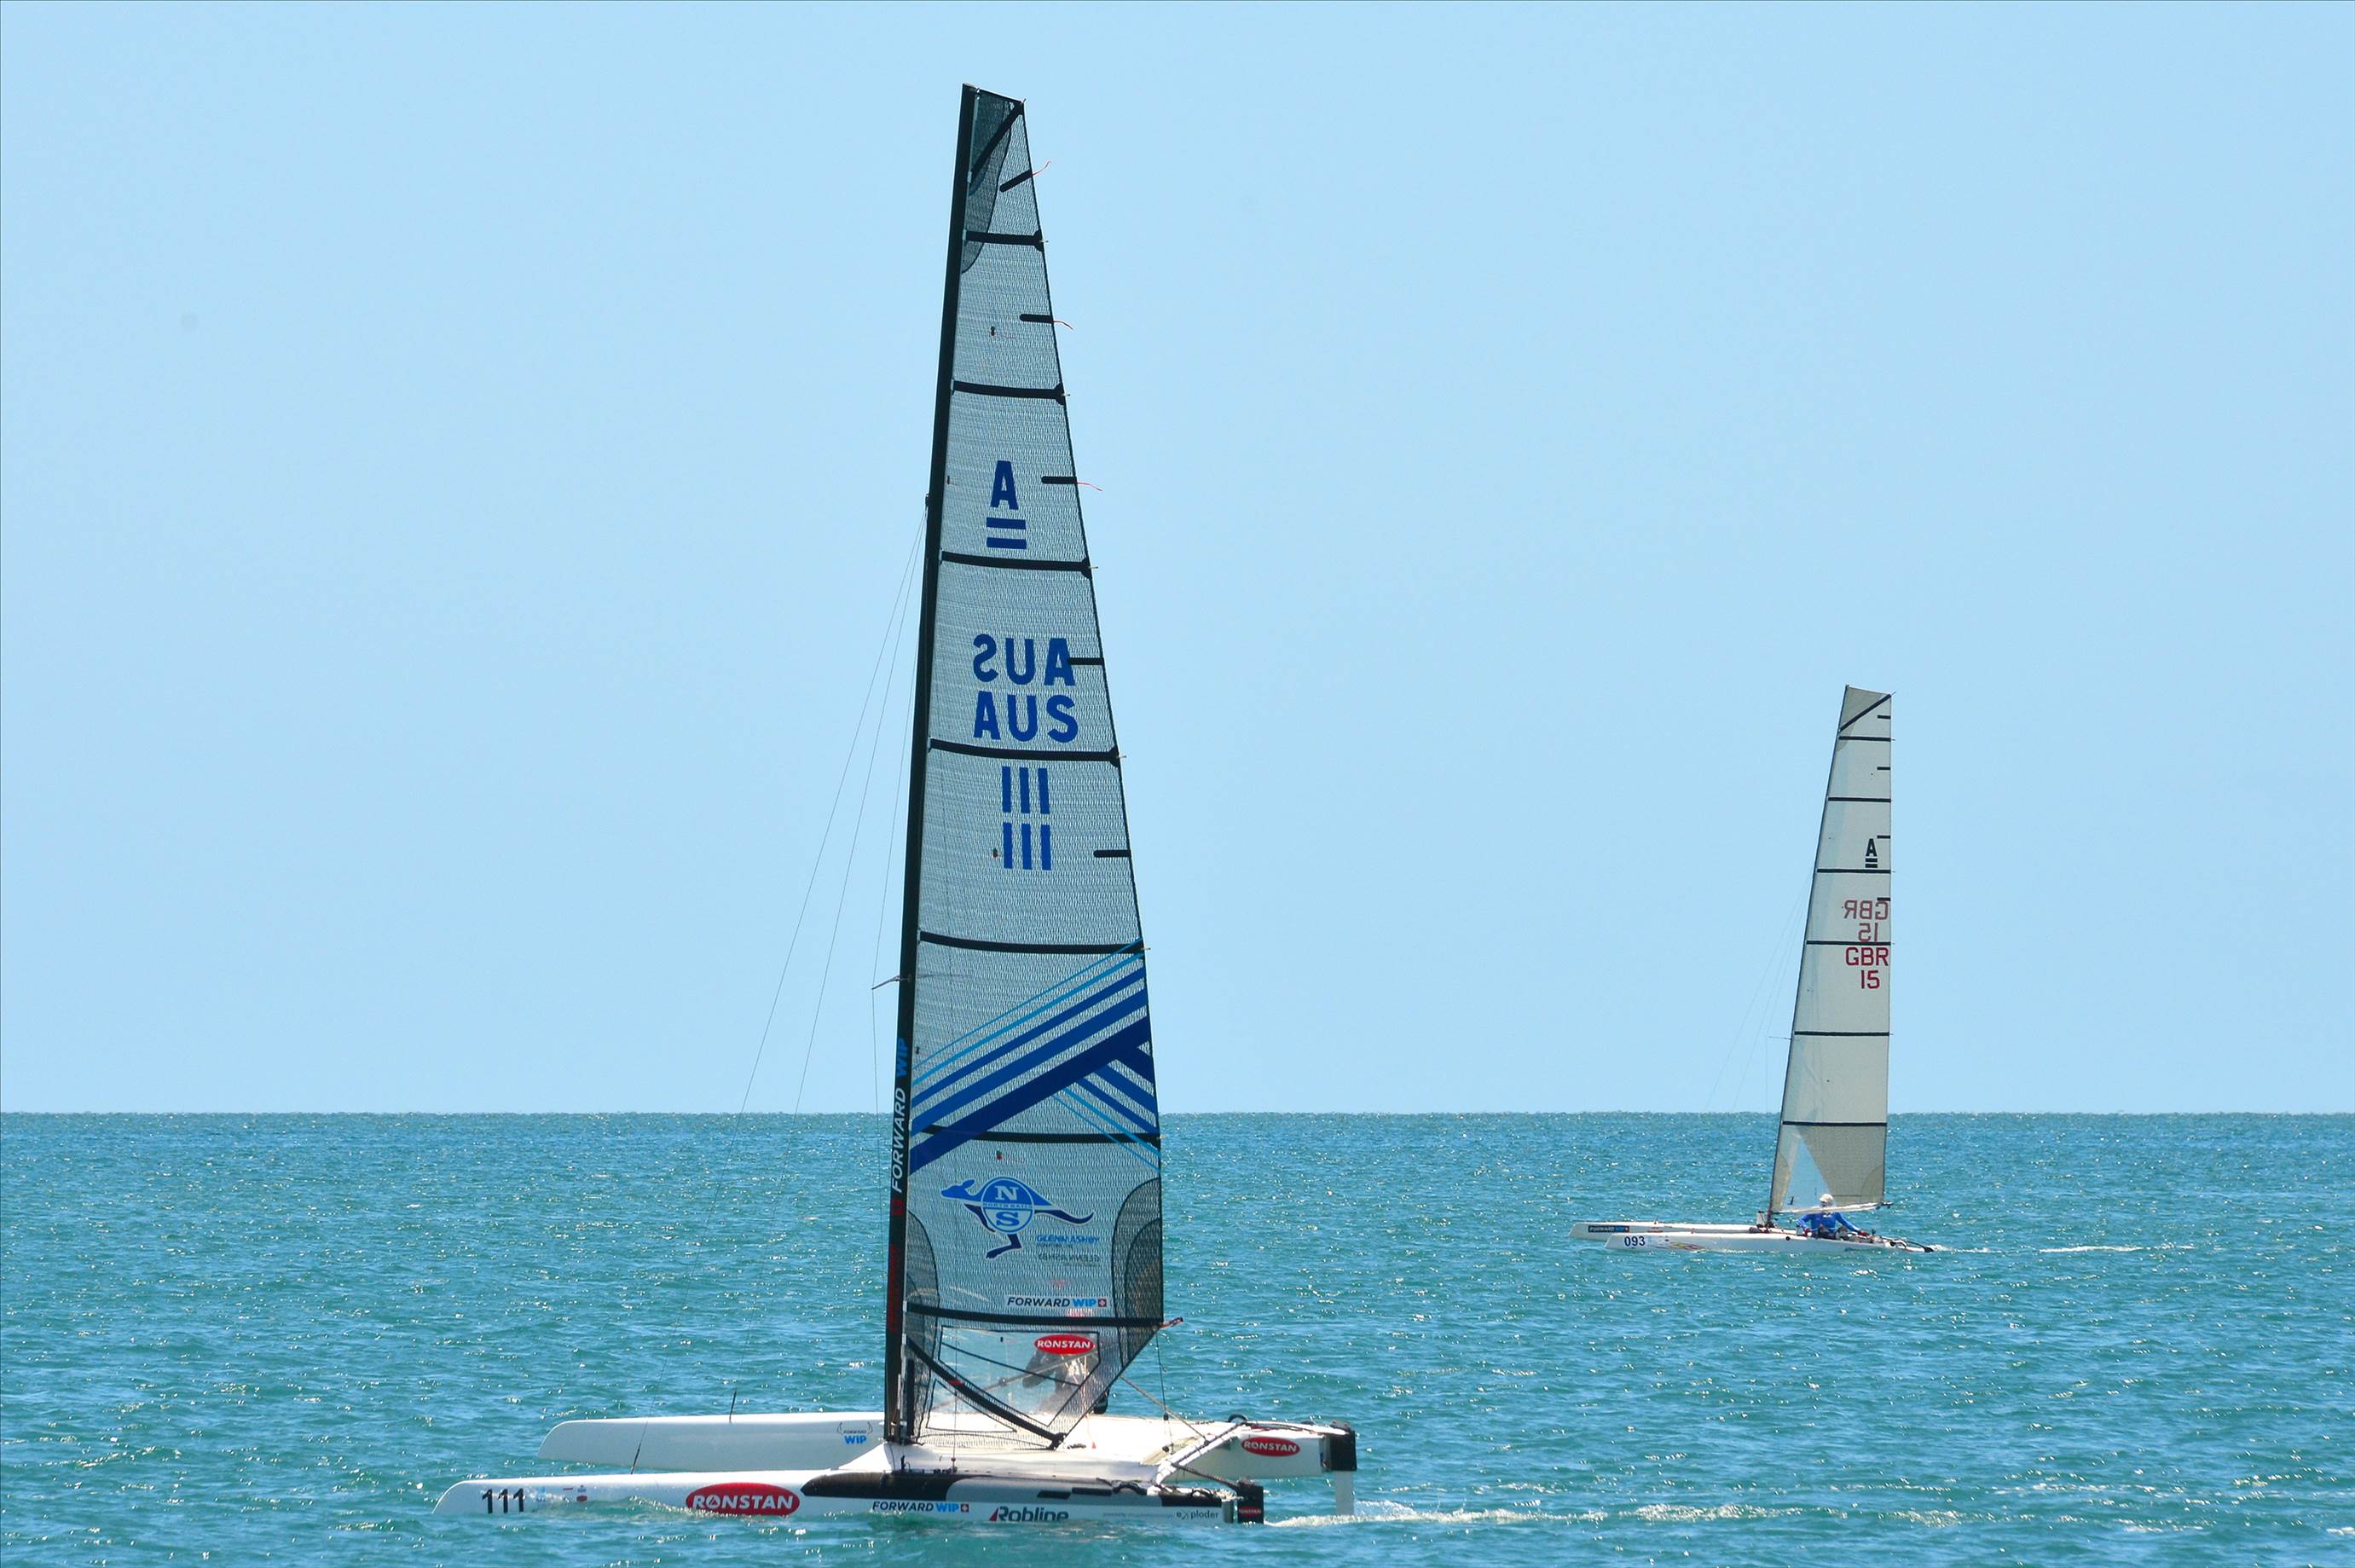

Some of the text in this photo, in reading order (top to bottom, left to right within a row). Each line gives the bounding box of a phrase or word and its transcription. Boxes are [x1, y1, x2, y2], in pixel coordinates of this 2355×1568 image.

[989, 460, 1019, 510] A
[973, 691, 1079, 743] AUS
[1865, 838, 1878, 857] A
[1845, 946, 1889, 966] GBR
[1860, 970, 1880, 989] 15
[892, 1037, 909, 1193] FORWARD WIP
[994, 1185, 1019, 1201] N
[995, 1211, 1020, 1227] S
[1623, 1235, 1646, 1247] 093
[1007, 1296, 1096, 1308] FORWARD WIP
[1037, 1339, 1091, 1349] RONSTAN
[845, 1435, 867, 1444] WIP
[1243, 1441, 1297, 1453] RONSTAN
[482, 1488, 524, 1513] 111
[692, 1495, 793, 1509] RONSTAN
[872, 1501, 959, 1513] FORWARD WIP
[998, 1506, 1069, 1522] Robline
